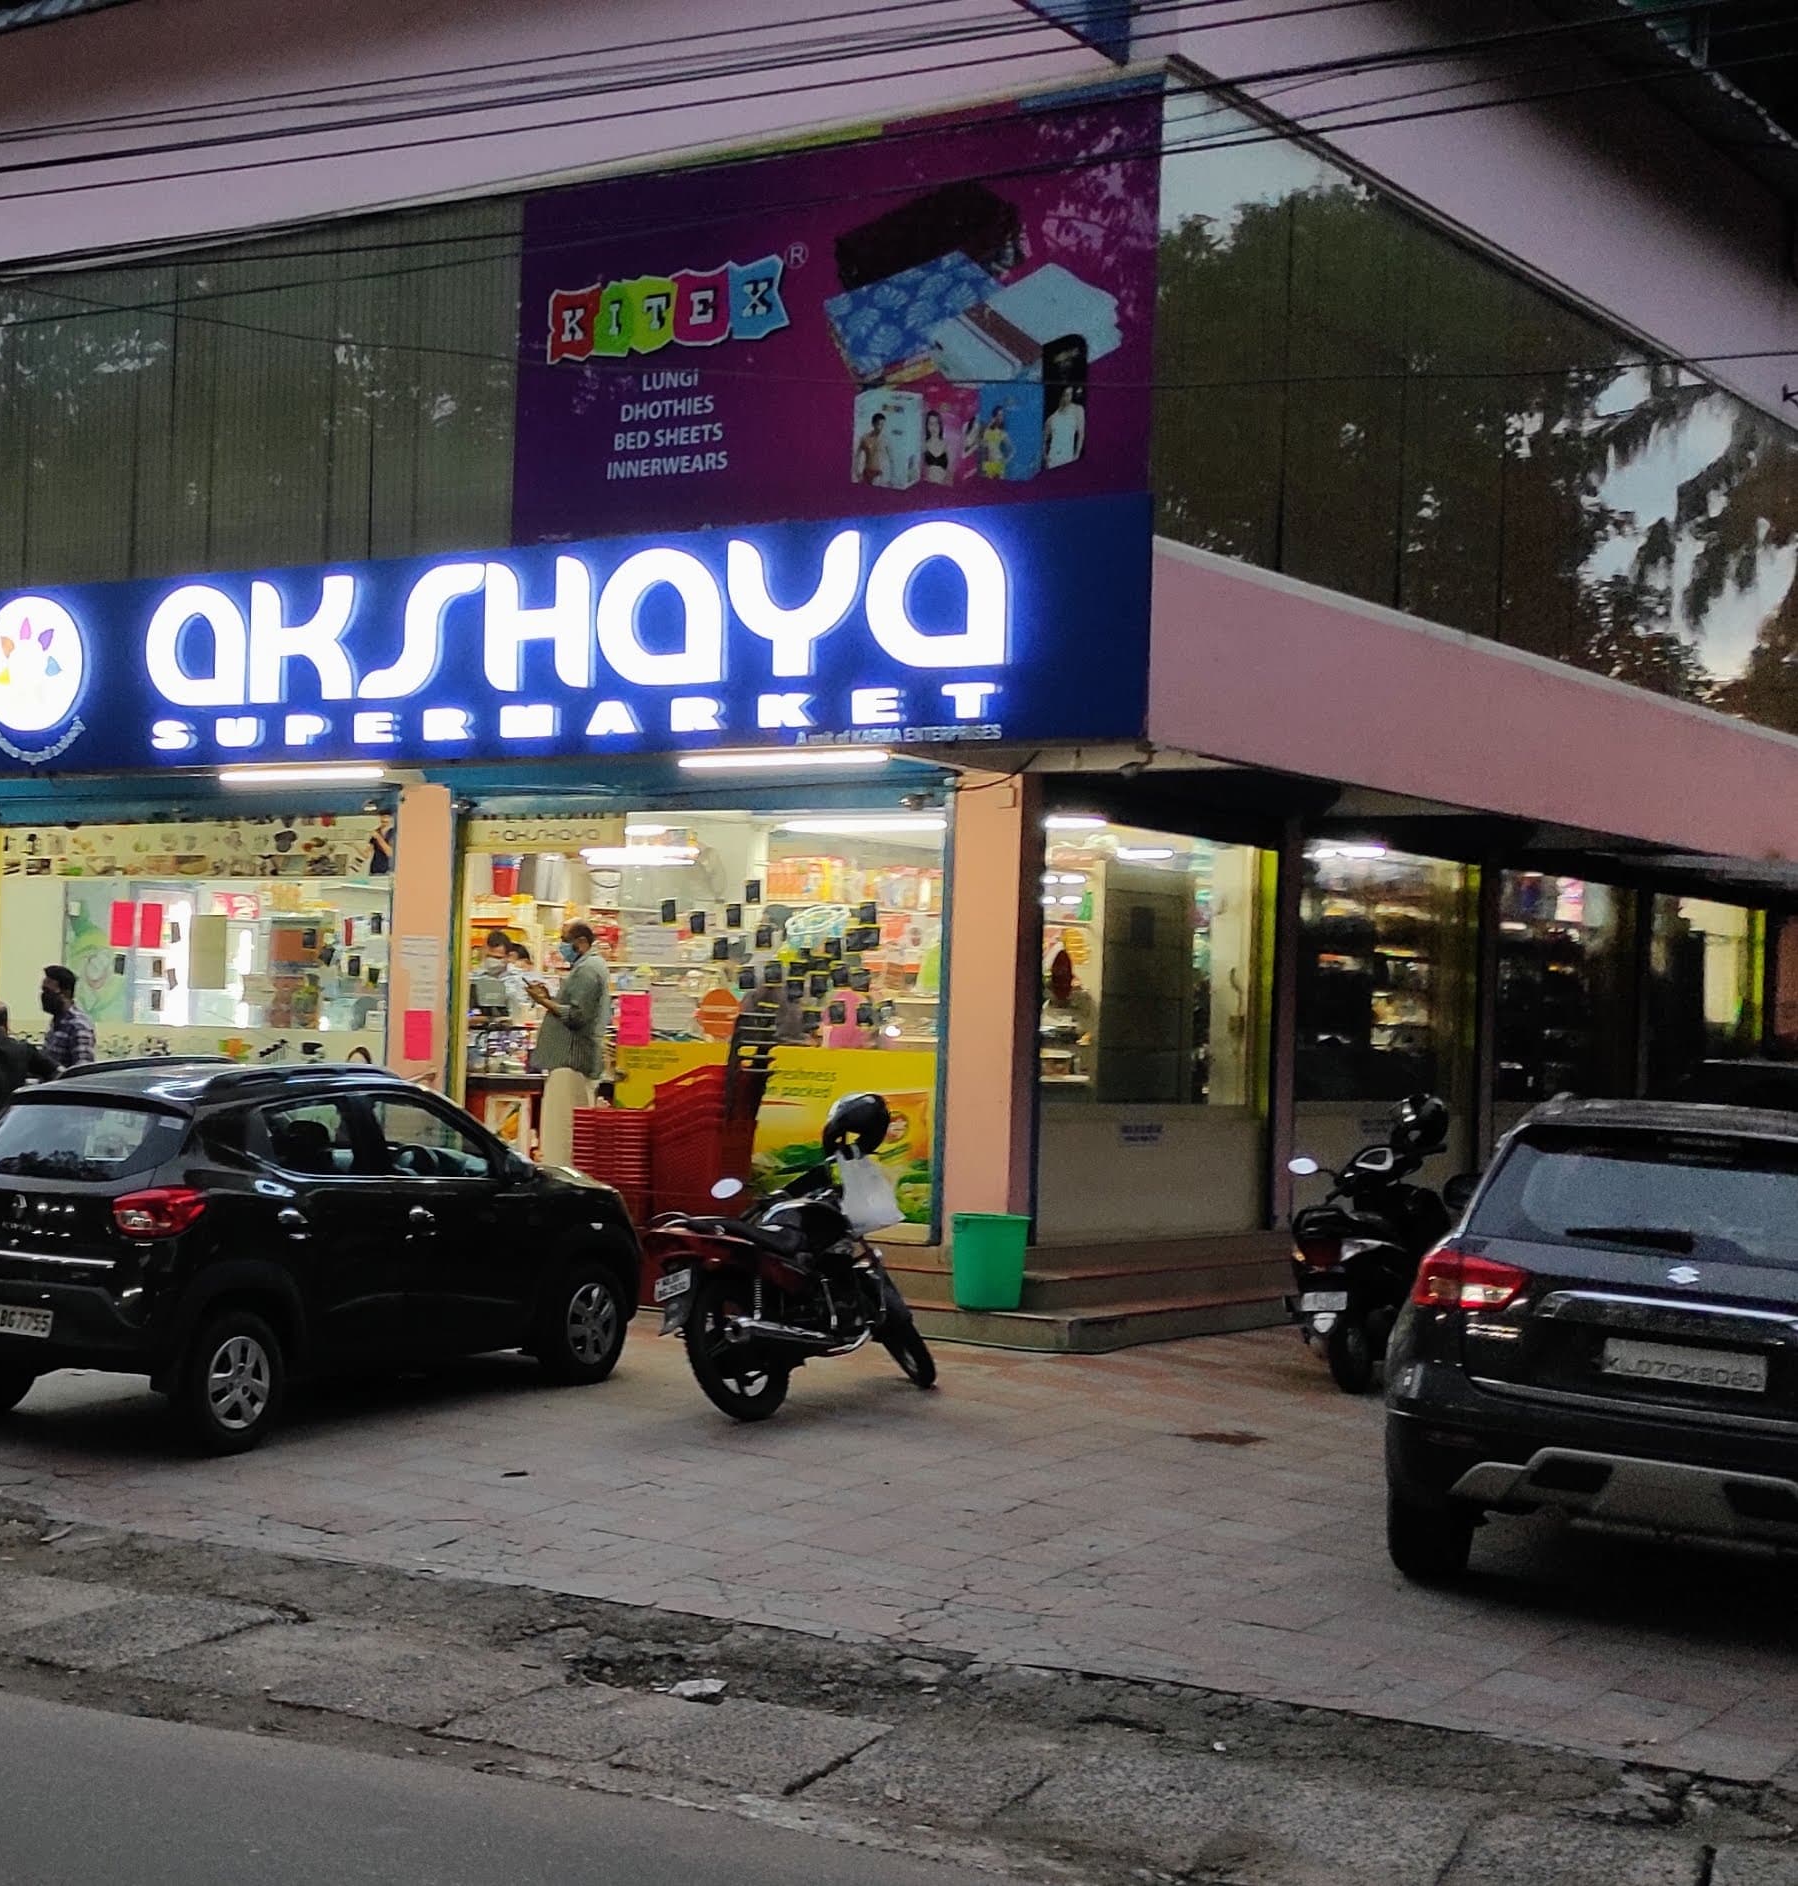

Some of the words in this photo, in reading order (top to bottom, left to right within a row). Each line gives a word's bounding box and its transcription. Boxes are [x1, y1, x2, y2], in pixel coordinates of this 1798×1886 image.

[561, 279, 776, 343] KITEX
[641, 368, 700, 391] LUNGI
[620, 395, 715, 422] DHOTHIES
[614, 430, 651, 451] BED
[654, 422, 724, 447] SHEETS
[606, 451, 729, 480] INNERWEARS
[151, 682, 1000, 750] SUPERMARKET
